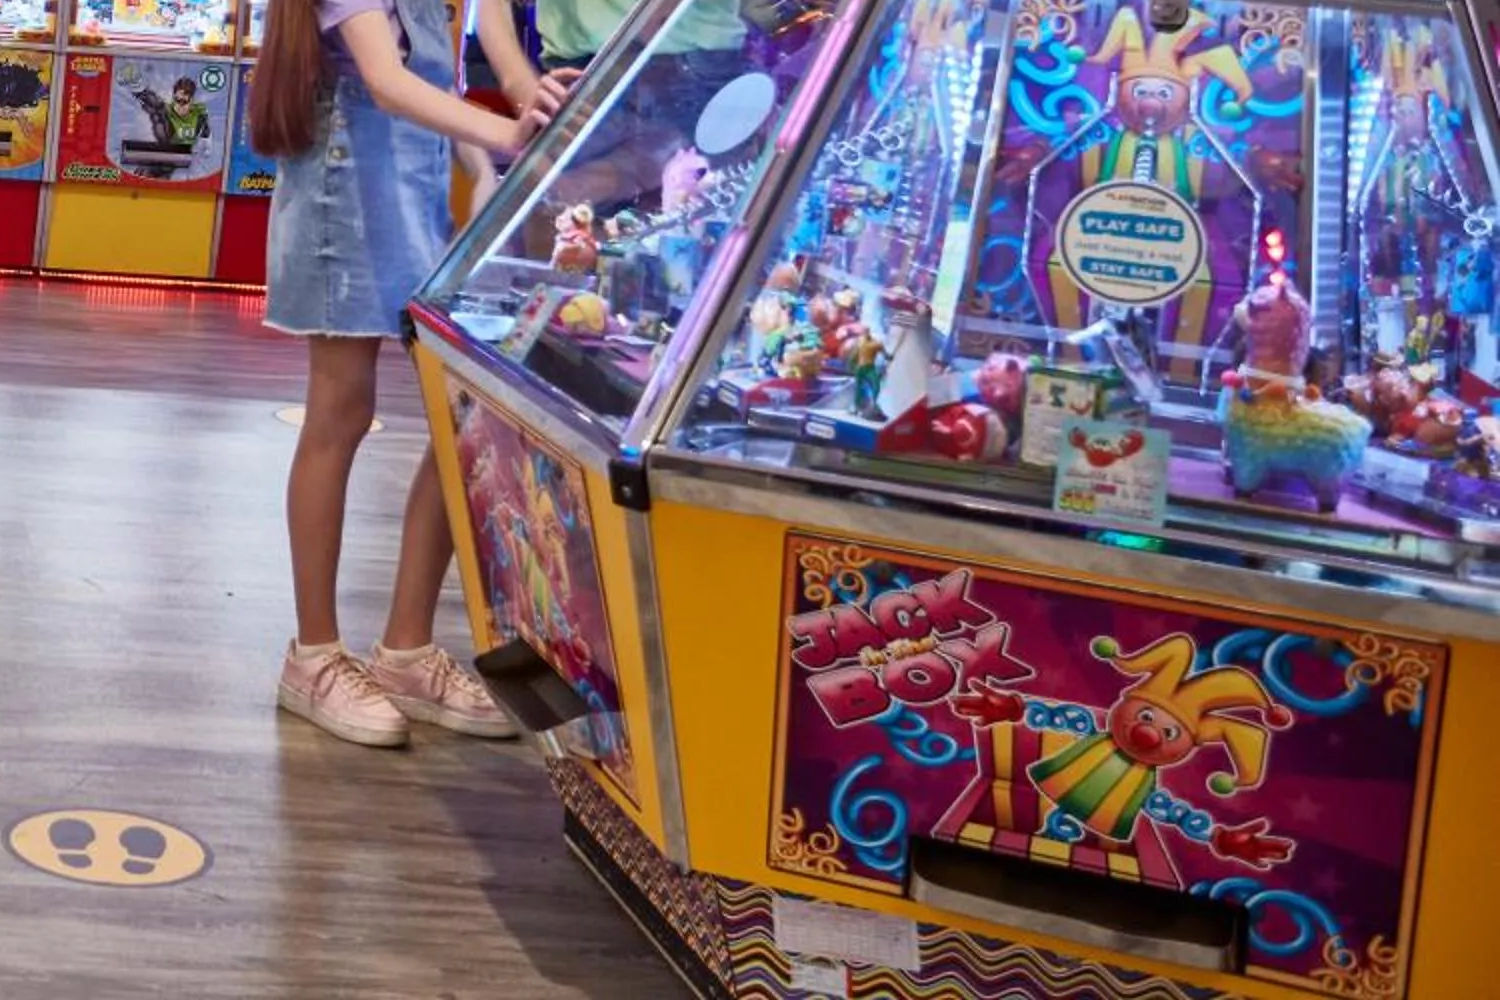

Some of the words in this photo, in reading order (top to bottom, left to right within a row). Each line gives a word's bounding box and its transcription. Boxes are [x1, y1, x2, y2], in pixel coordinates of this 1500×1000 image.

[1085, 217, 1130, 231] PLAY
[1135, 221, 1180, 237] SAFE
[1091, 261, 1124, 274] STAY
[1130, 265, 1165, 279] SAFE
[786, 568, 996, 671] JACK
[806, 621, 1037, 729] BOX
